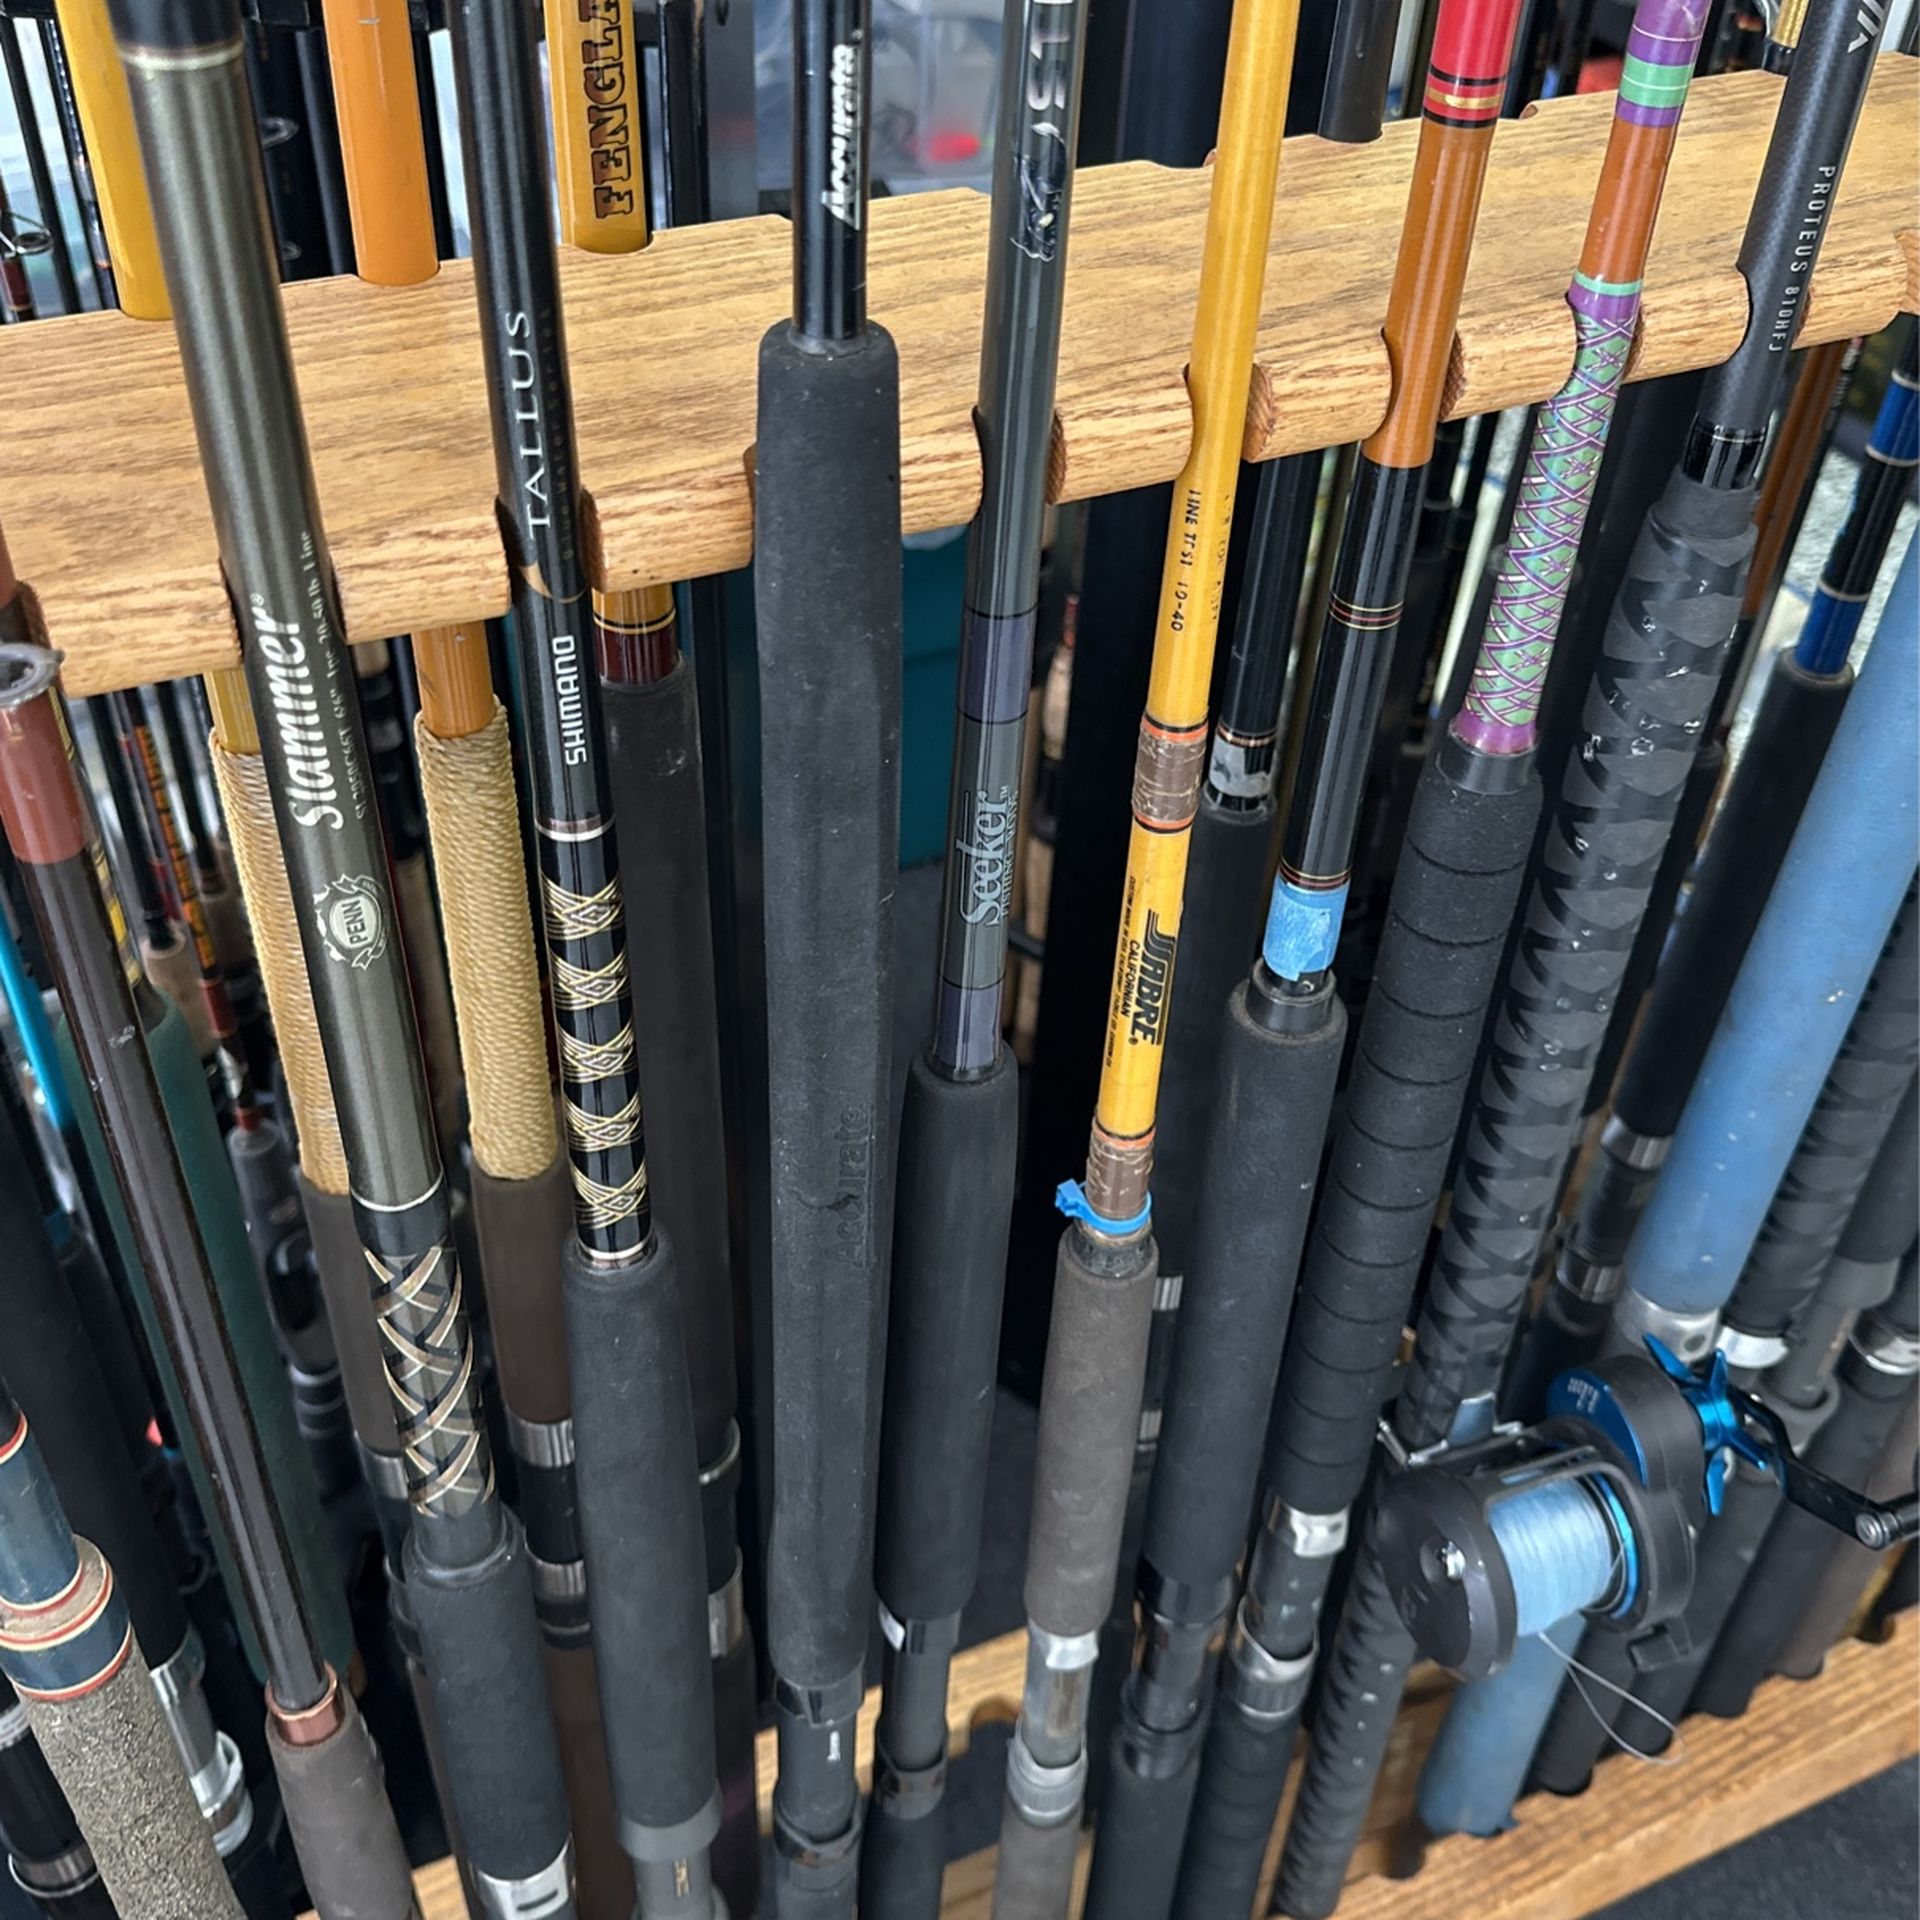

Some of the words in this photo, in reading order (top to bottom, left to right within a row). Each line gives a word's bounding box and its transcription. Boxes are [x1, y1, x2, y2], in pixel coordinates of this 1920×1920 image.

[1790, 165, 1836, 272] PROTEUS
[1769, 285, 1800, 352] 810HFJ
[505, 312, 550, 539] TALLUS
[253, 609, 344, 830] Slammer
[552, 635, 587, 766] SHIMANO
[341, 901, 368, 944] PENN
[955, 790, 1007, 927] Seeker
[1121, 939, 1140, 1018] CALIFORNIAN
[1131, 909, 1176, 1046] SABRE
